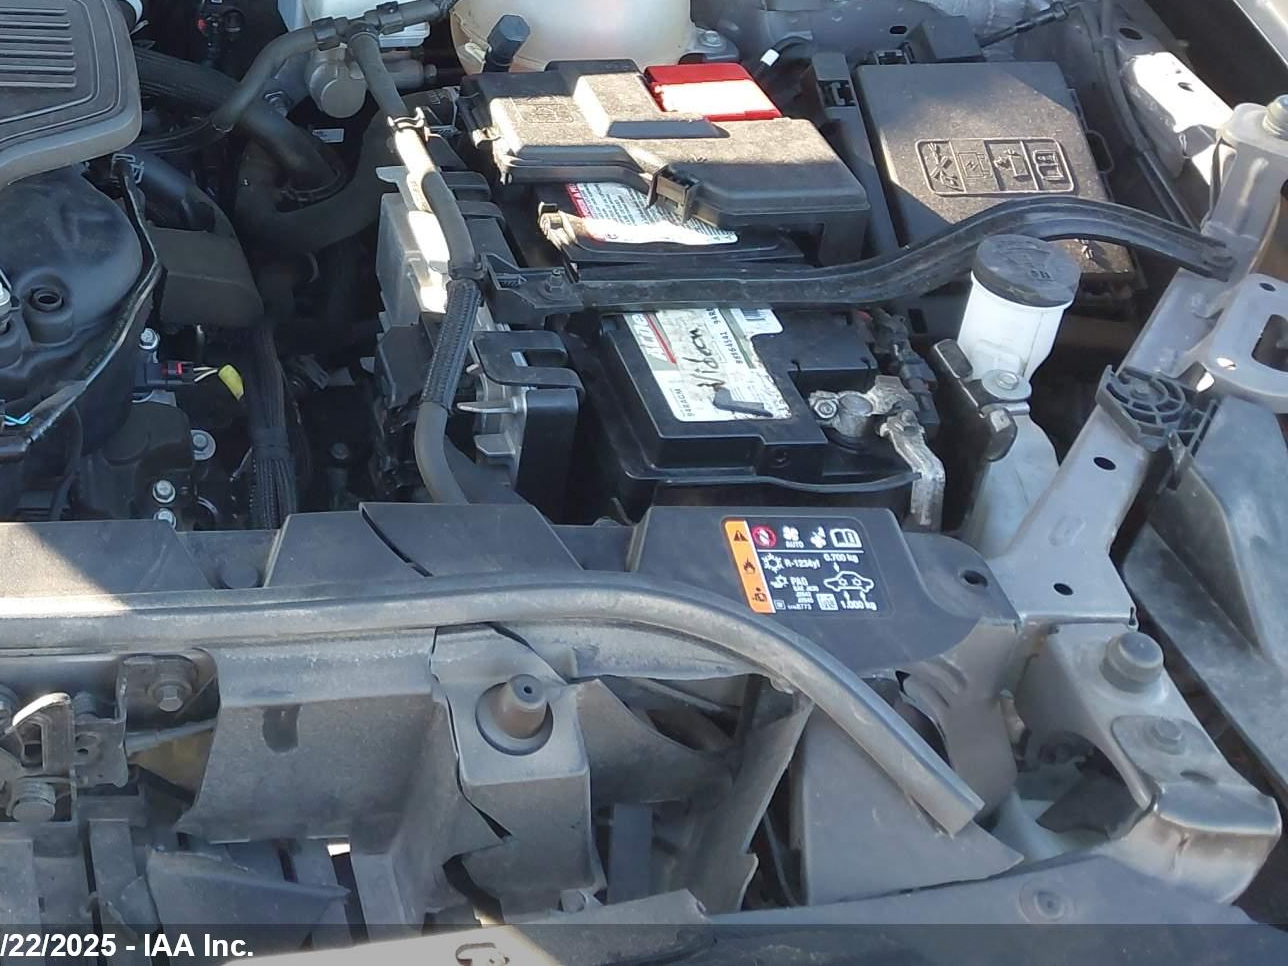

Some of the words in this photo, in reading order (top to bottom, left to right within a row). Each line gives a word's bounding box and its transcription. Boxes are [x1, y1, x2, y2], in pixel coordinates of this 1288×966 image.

[785, 540, 805, 548] AUTO
[823, 553, 847, 562] 0.700
[846, 553, 860, 564] kg
[840, 600, 865, 610] 1.000
[864, 600, 877, 611] kg
